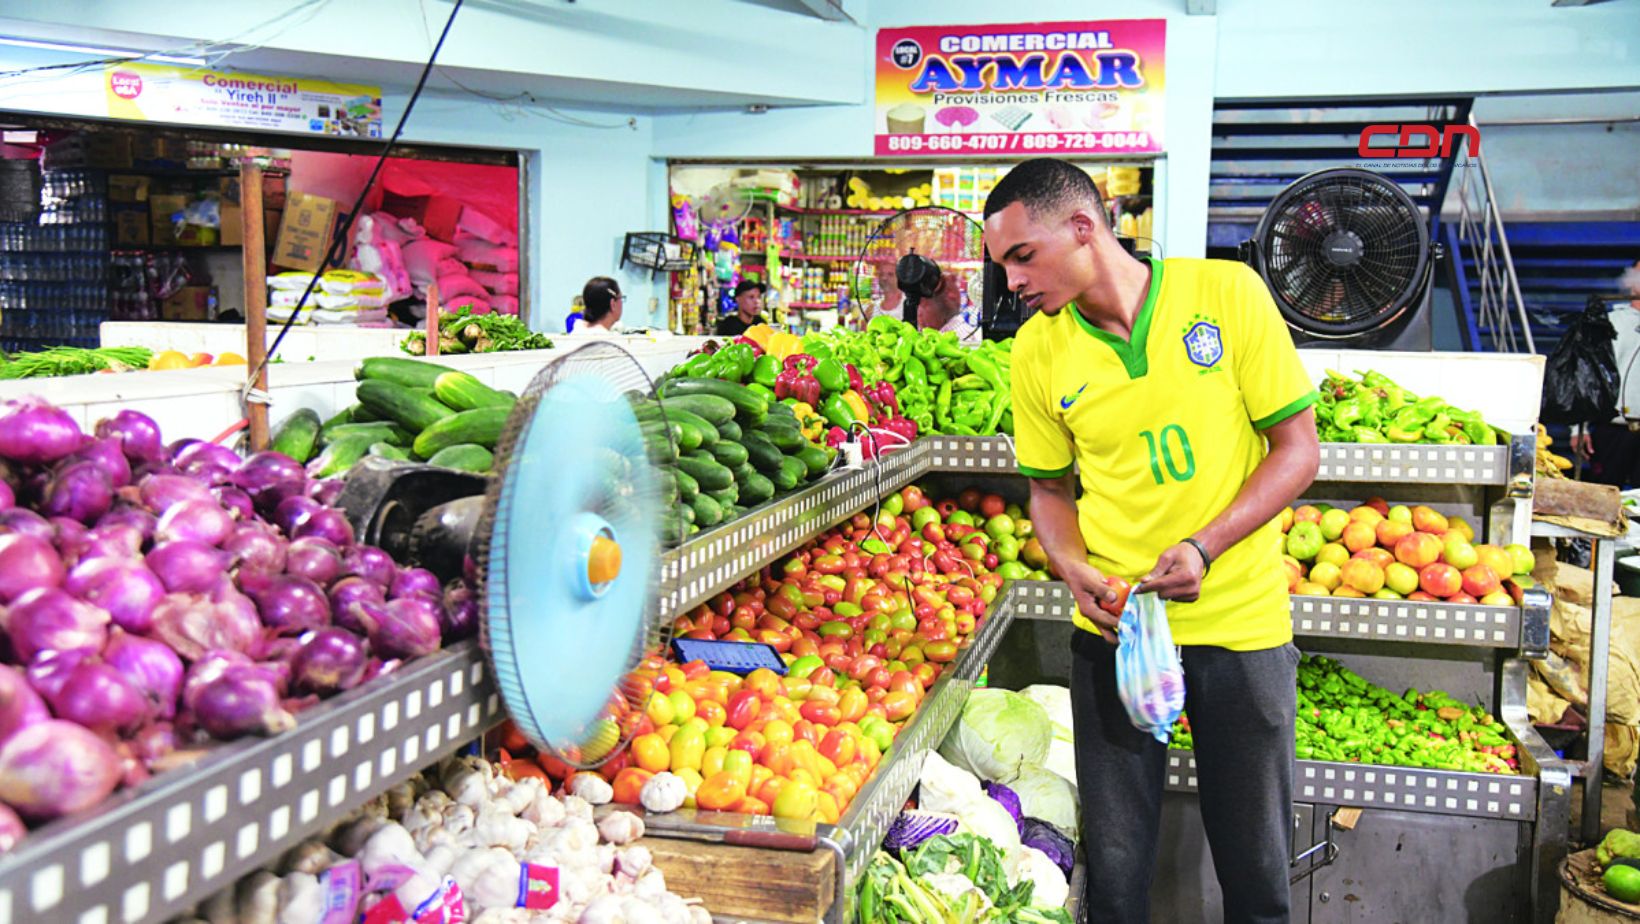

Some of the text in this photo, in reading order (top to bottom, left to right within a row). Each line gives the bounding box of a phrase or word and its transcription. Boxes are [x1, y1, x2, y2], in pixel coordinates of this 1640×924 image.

[940, 32, 1113, 52] COMERCIAL
[911, 51, 1143, 91] AYMAR
[112, 76, 140, 86] Local
[203, 74, 298, 94] Comercial
[226, 88, 264, 103] Yireh
[934, 91, 1118, 105] Provisiones Frescas
[888, 135, 1008, 150] 809-660-4707
[1023, 133, 1149, 149] 809-729-0044
[1139, 424, 1196, 485] 10
